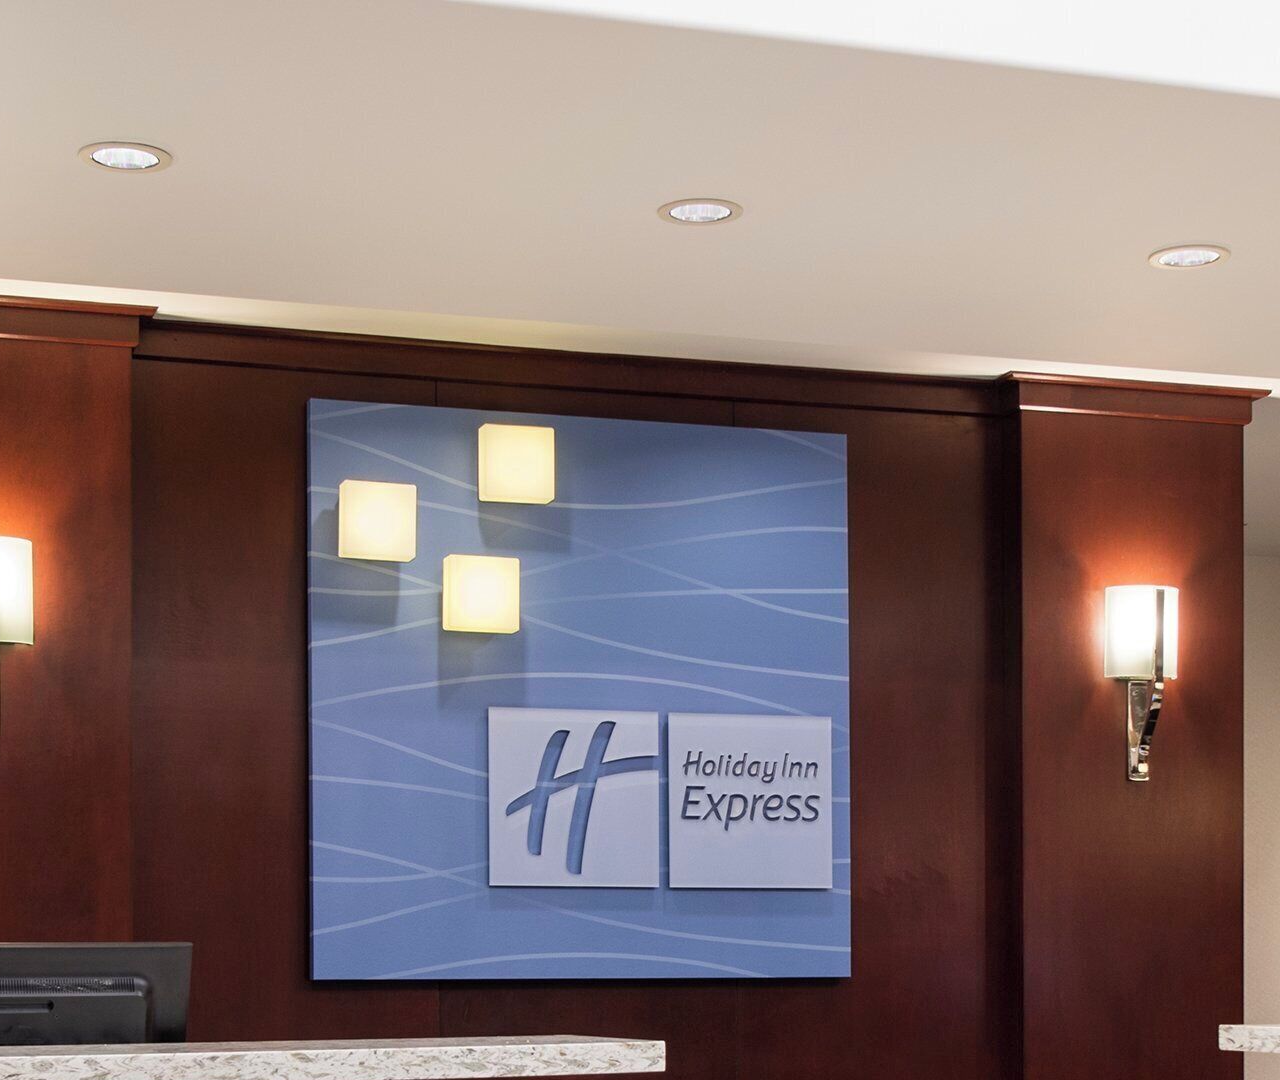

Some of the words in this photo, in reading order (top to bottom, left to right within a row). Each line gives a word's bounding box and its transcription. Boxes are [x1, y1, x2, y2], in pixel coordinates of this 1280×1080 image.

[682, 750, 778, 783] Holiday
[782, 752, 819, 778] Inn
[680, 785, 821, 832] Express
